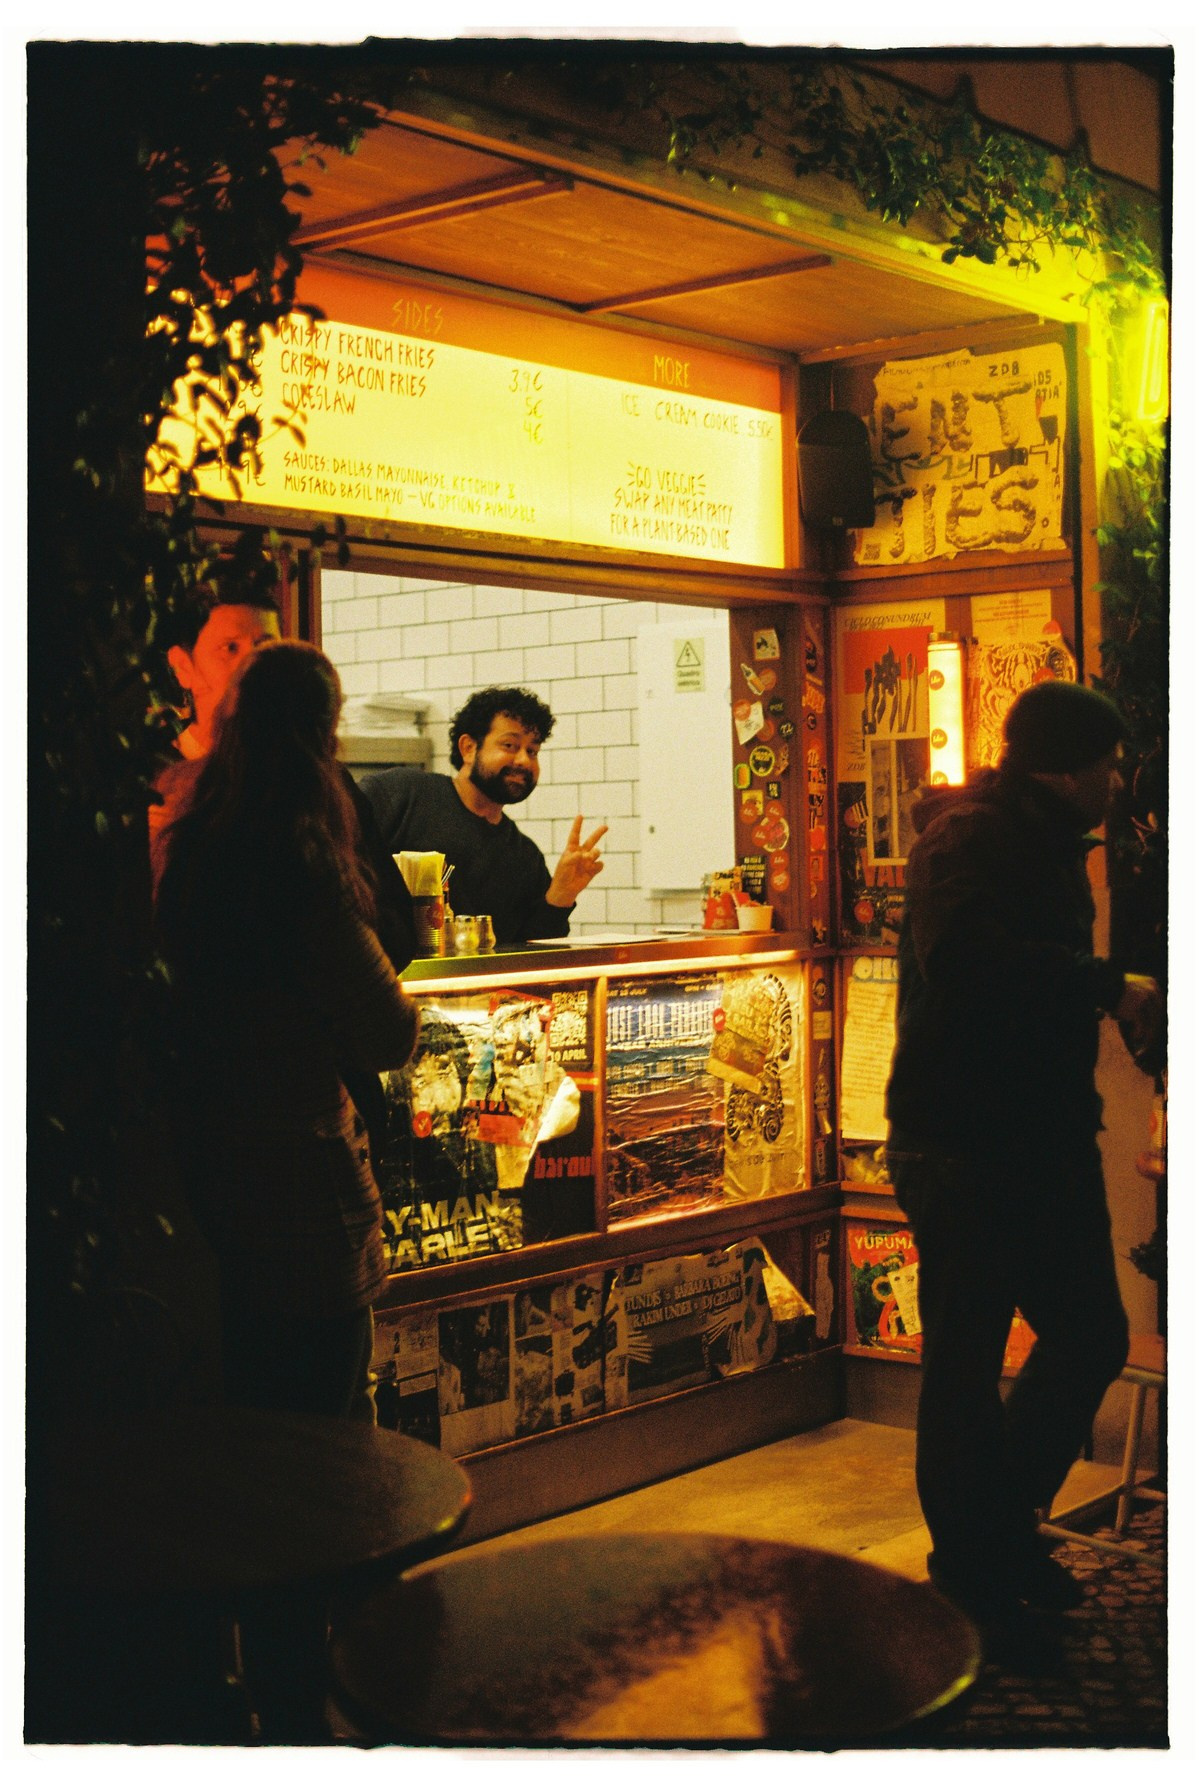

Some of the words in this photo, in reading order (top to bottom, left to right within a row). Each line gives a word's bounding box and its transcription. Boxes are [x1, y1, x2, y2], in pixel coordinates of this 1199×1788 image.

[391, 298, 444, 335] SIDES
[280, 320, 332, 351] CRISPY
[338, 333, 393, 363] FRENCH
[398, 343, 435, 369] FRIES
[280, 350, 331, 381] CRISPY
[337, 361, 385, 392] BACON
[390, 371, 427, 398] FRIES
[654, 355, 691, 388] MORE
[282, 382, 356, 415] COLESLAW
[621, 393, 641, 417] ICE
[655, 401, 698, 428] CREAM
[703, 412, 740, 436] COOKIE
[522, 420, 545, 445] 4€
[283, 450, 330, 473] SAUCES:
[452, 475, 500, 496] KETCHUP
[635, 465, 652, 489] GO
[657, 469, 697, 497] VEGGIE
[284, 473, 337, 497] MUSTARD
[340, 482, 373, 501] BASIL
[376, 485, 404, 504] MAYO
[438, 493, 481, 515] OPTIONS
[484, 501, 537, 523] AVAILABLE
[614, 487, 650, 512] SWAP
[654, 494, 675, 515] ANY
[678, 497, 704, 519] MEAT
[706, 502, 733, 525] PATTY
[610, 513, 629, 536] FOR
[632, 516, 640, 537] A
[710, 527, 730, 550] ONE
[381, 1189, 501, 1239] Y-MAN
[664, 1300, 693, 1321] UNDER
